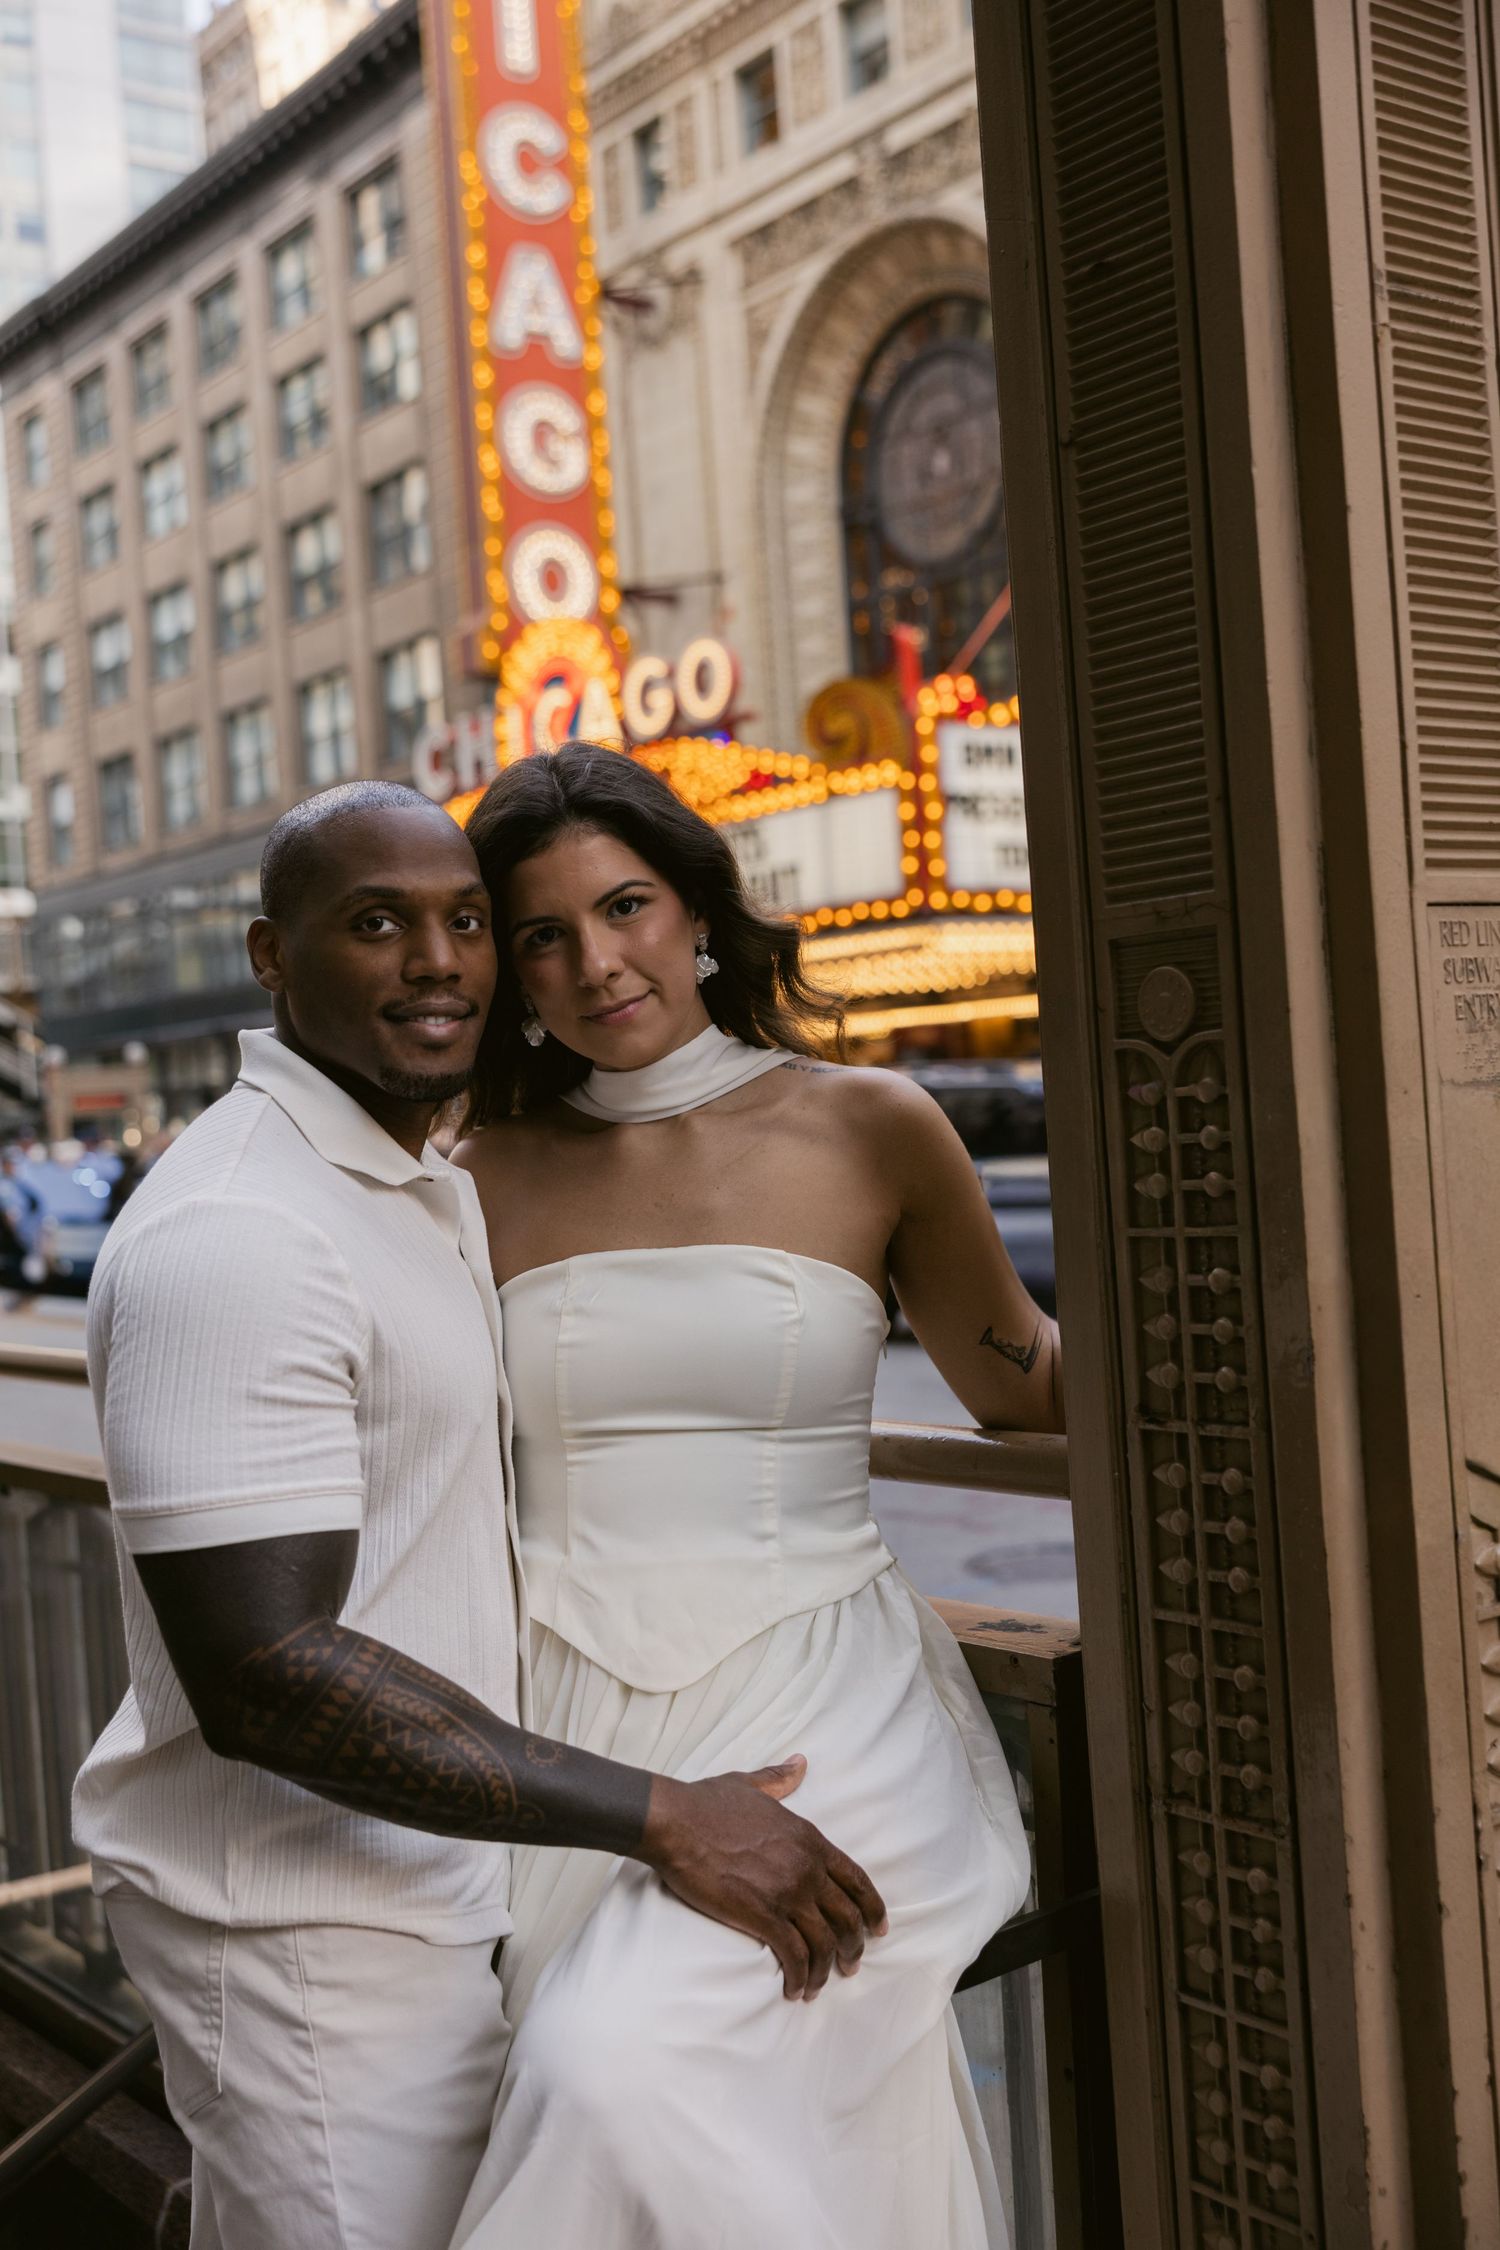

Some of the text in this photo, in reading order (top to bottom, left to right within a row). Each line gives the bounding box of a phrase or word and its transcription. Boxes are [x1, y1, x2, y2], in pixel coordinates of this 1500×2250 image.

[411, 637, 734, 802] CHICAGO
[1439, 920, 1470, 948] RED
[1454, 993, 1500, 1021] ENTR
